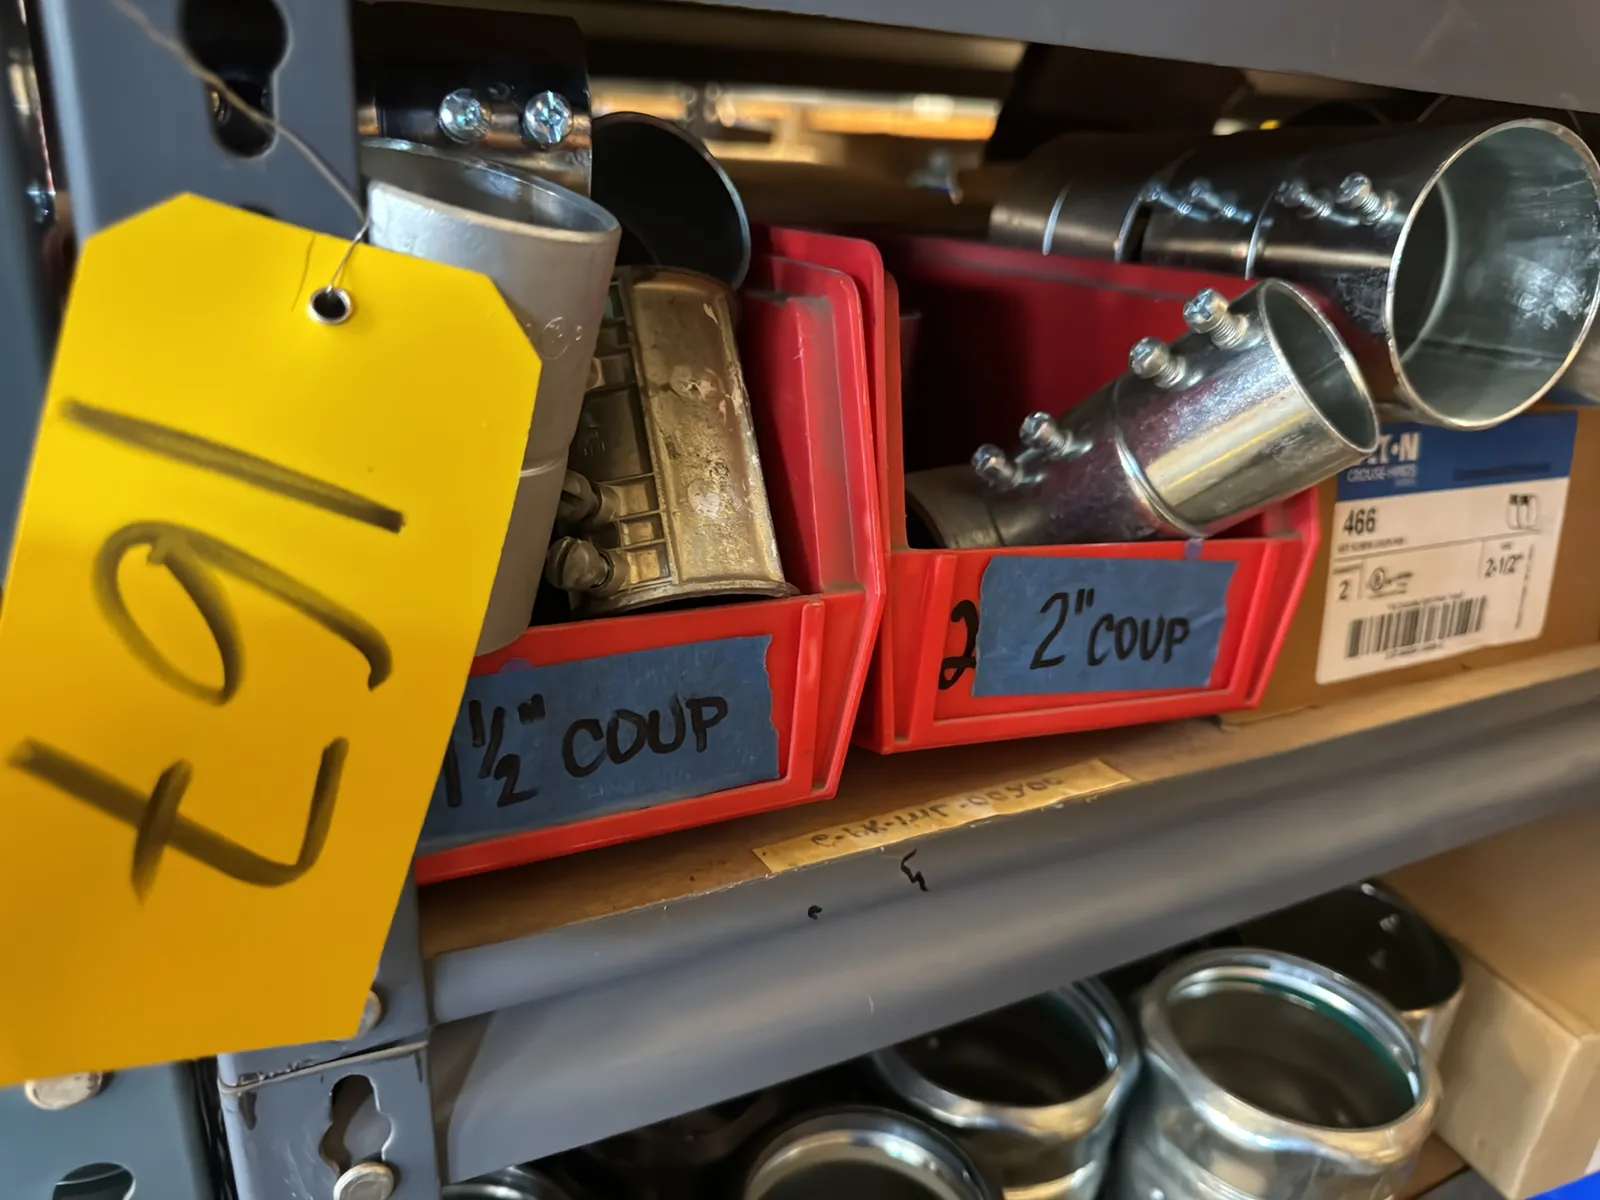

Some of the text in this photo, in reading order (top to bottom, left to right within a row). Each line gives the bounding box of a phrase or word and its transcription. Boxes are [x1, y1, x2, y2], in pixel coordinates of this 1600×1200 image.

[1343, 506, 1377, 536] 466
[1029, 588, 1191, 670] 2" COUP
[1338, 580, 1350, 600] 2
[8, 397, 406, 906] 167
[562, 694, 728, 778] COUP
